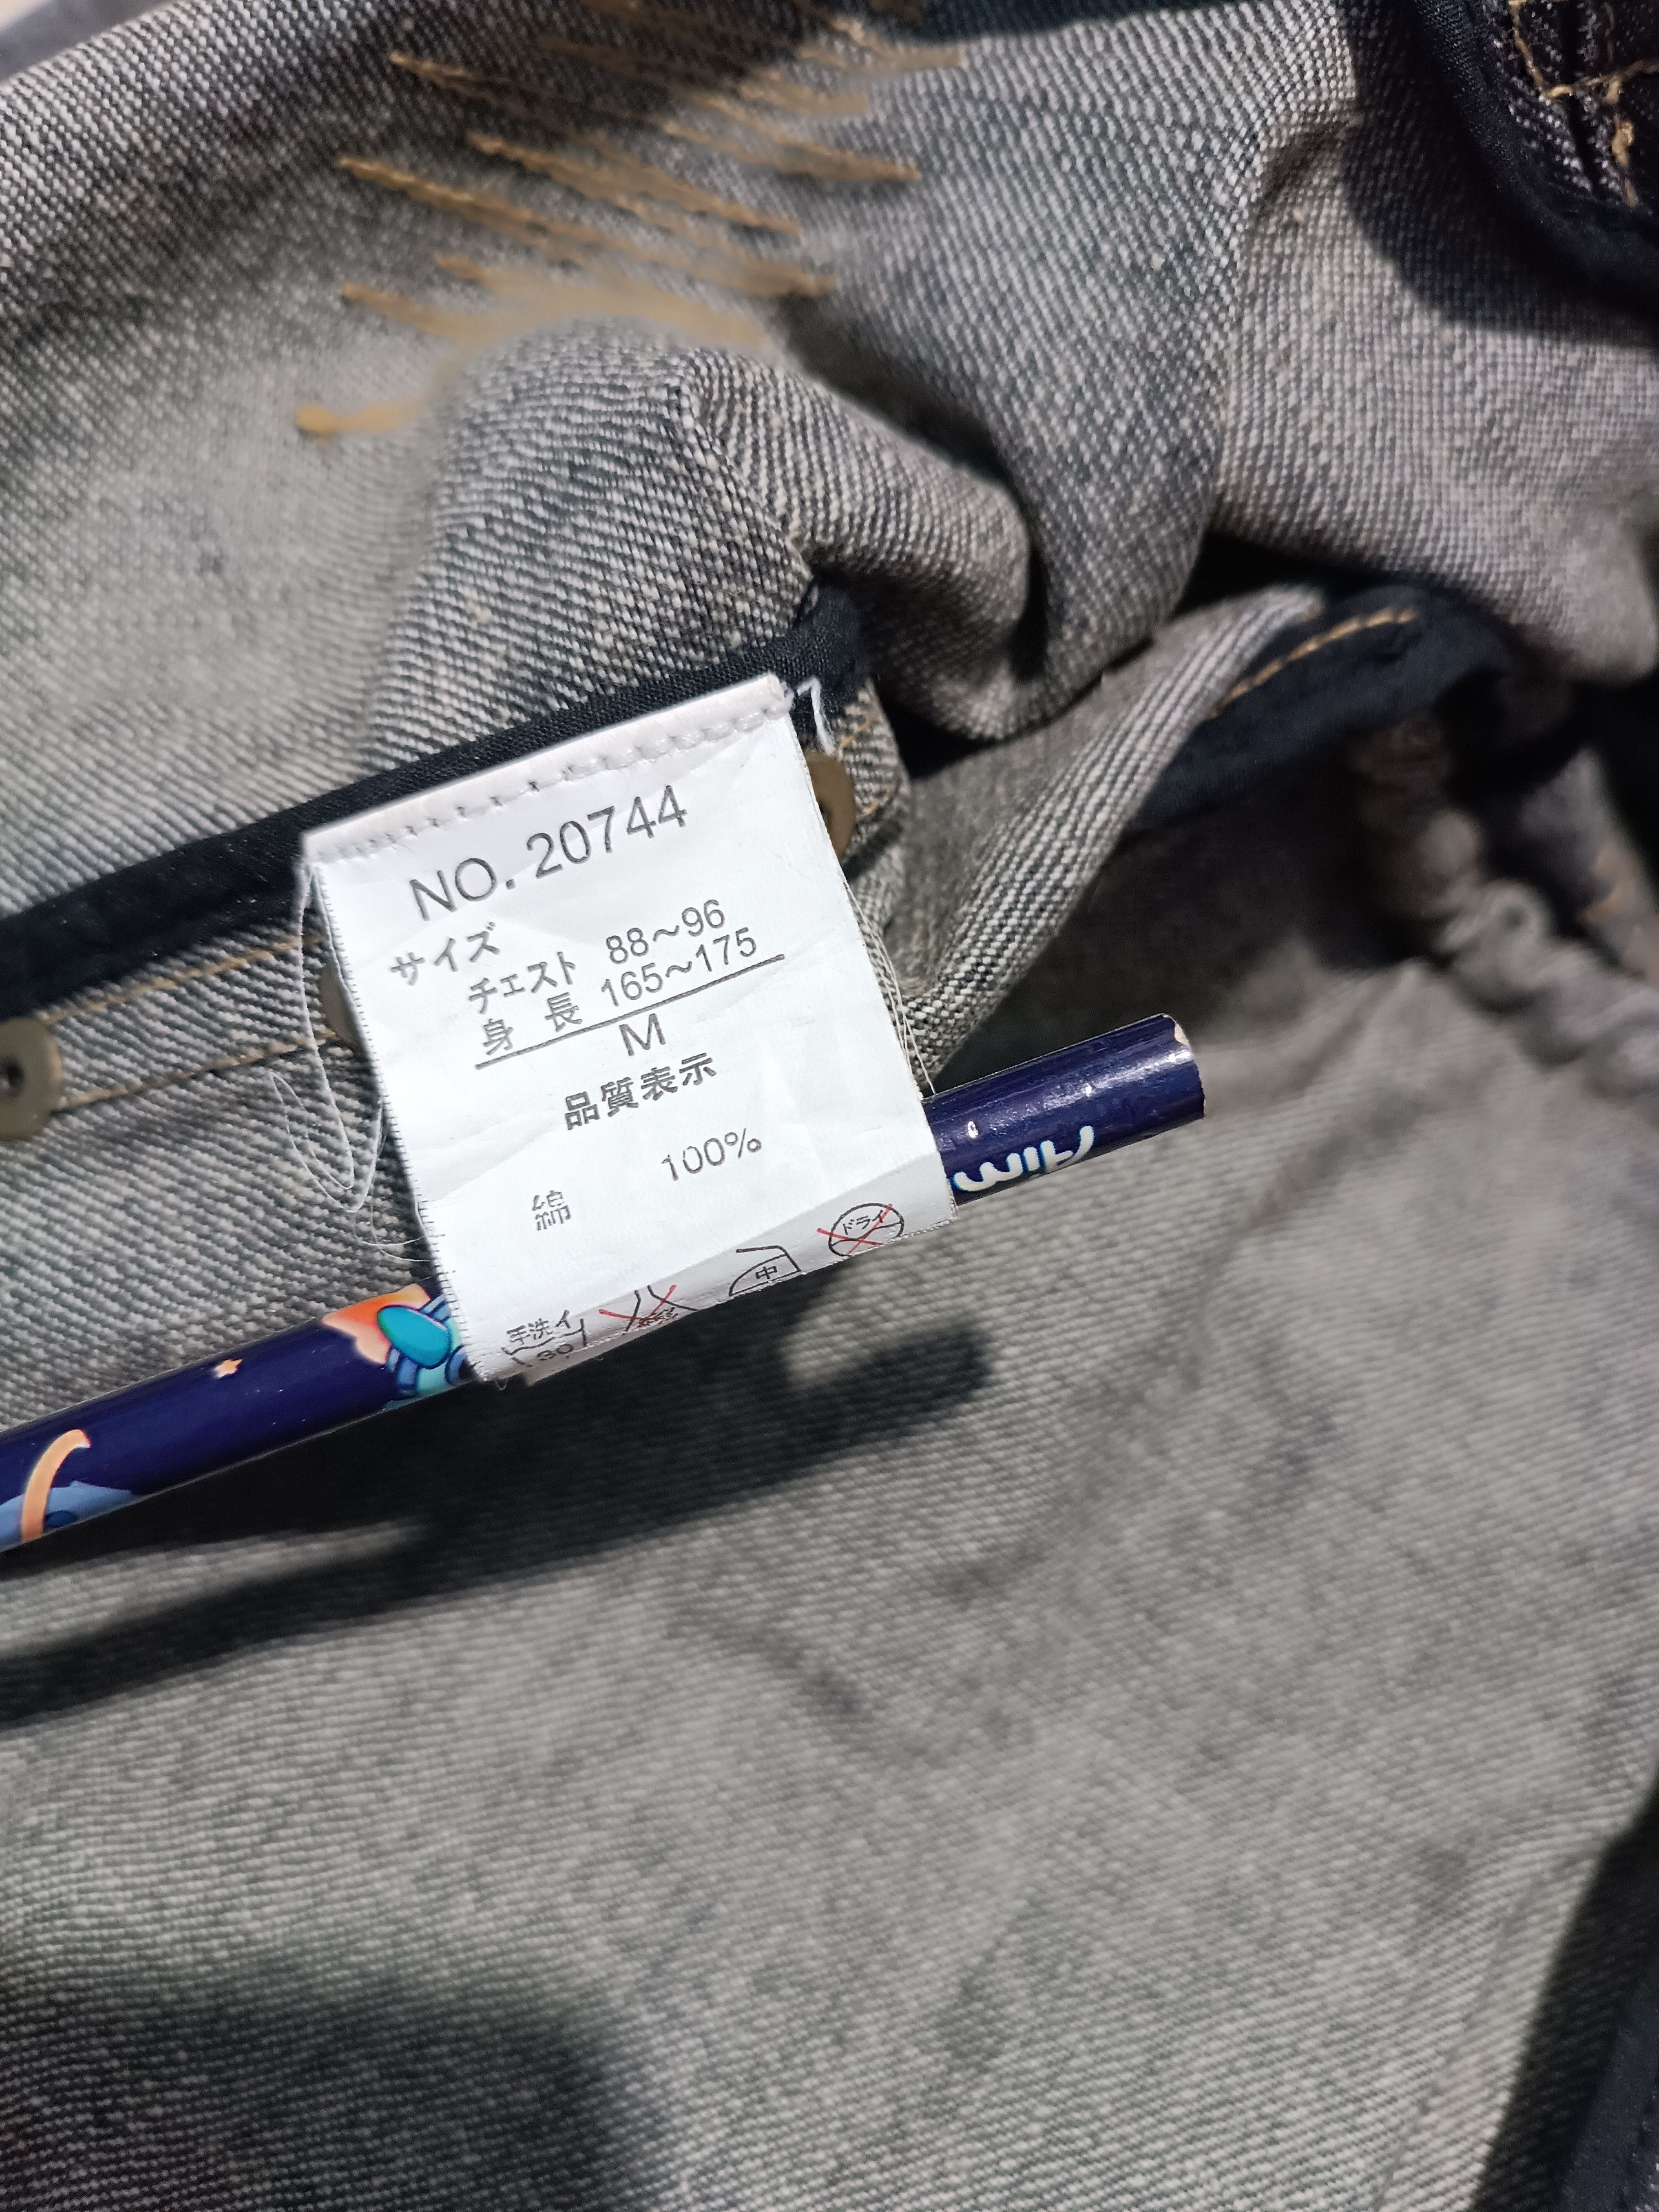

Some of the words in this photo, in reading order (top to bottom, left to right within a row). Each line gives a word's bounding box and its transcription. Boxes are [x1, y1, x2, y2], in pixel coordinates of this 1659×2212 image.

[409, 857, 516, 921] NO.
[526, 785, 687, 879] 20744
[389, 921, 500, 986] サイズ
[468, 951, 576, 1015] チェスト
[482, 1018, 514, 1055] 身
[544, 992, 583, 1032] 長
[619, 1013, 666, 1056] M
[564, 1052, 717, 1131] 品質表示
[532, 1190, 572, 1232] 綿
[661, 1128, 762, 1181] 100%
[842, 1210, 884, 1235] ドライ
[755, 1266, 778, 1280] 中
[506, 1309, 571, 1345] 手洗イ
